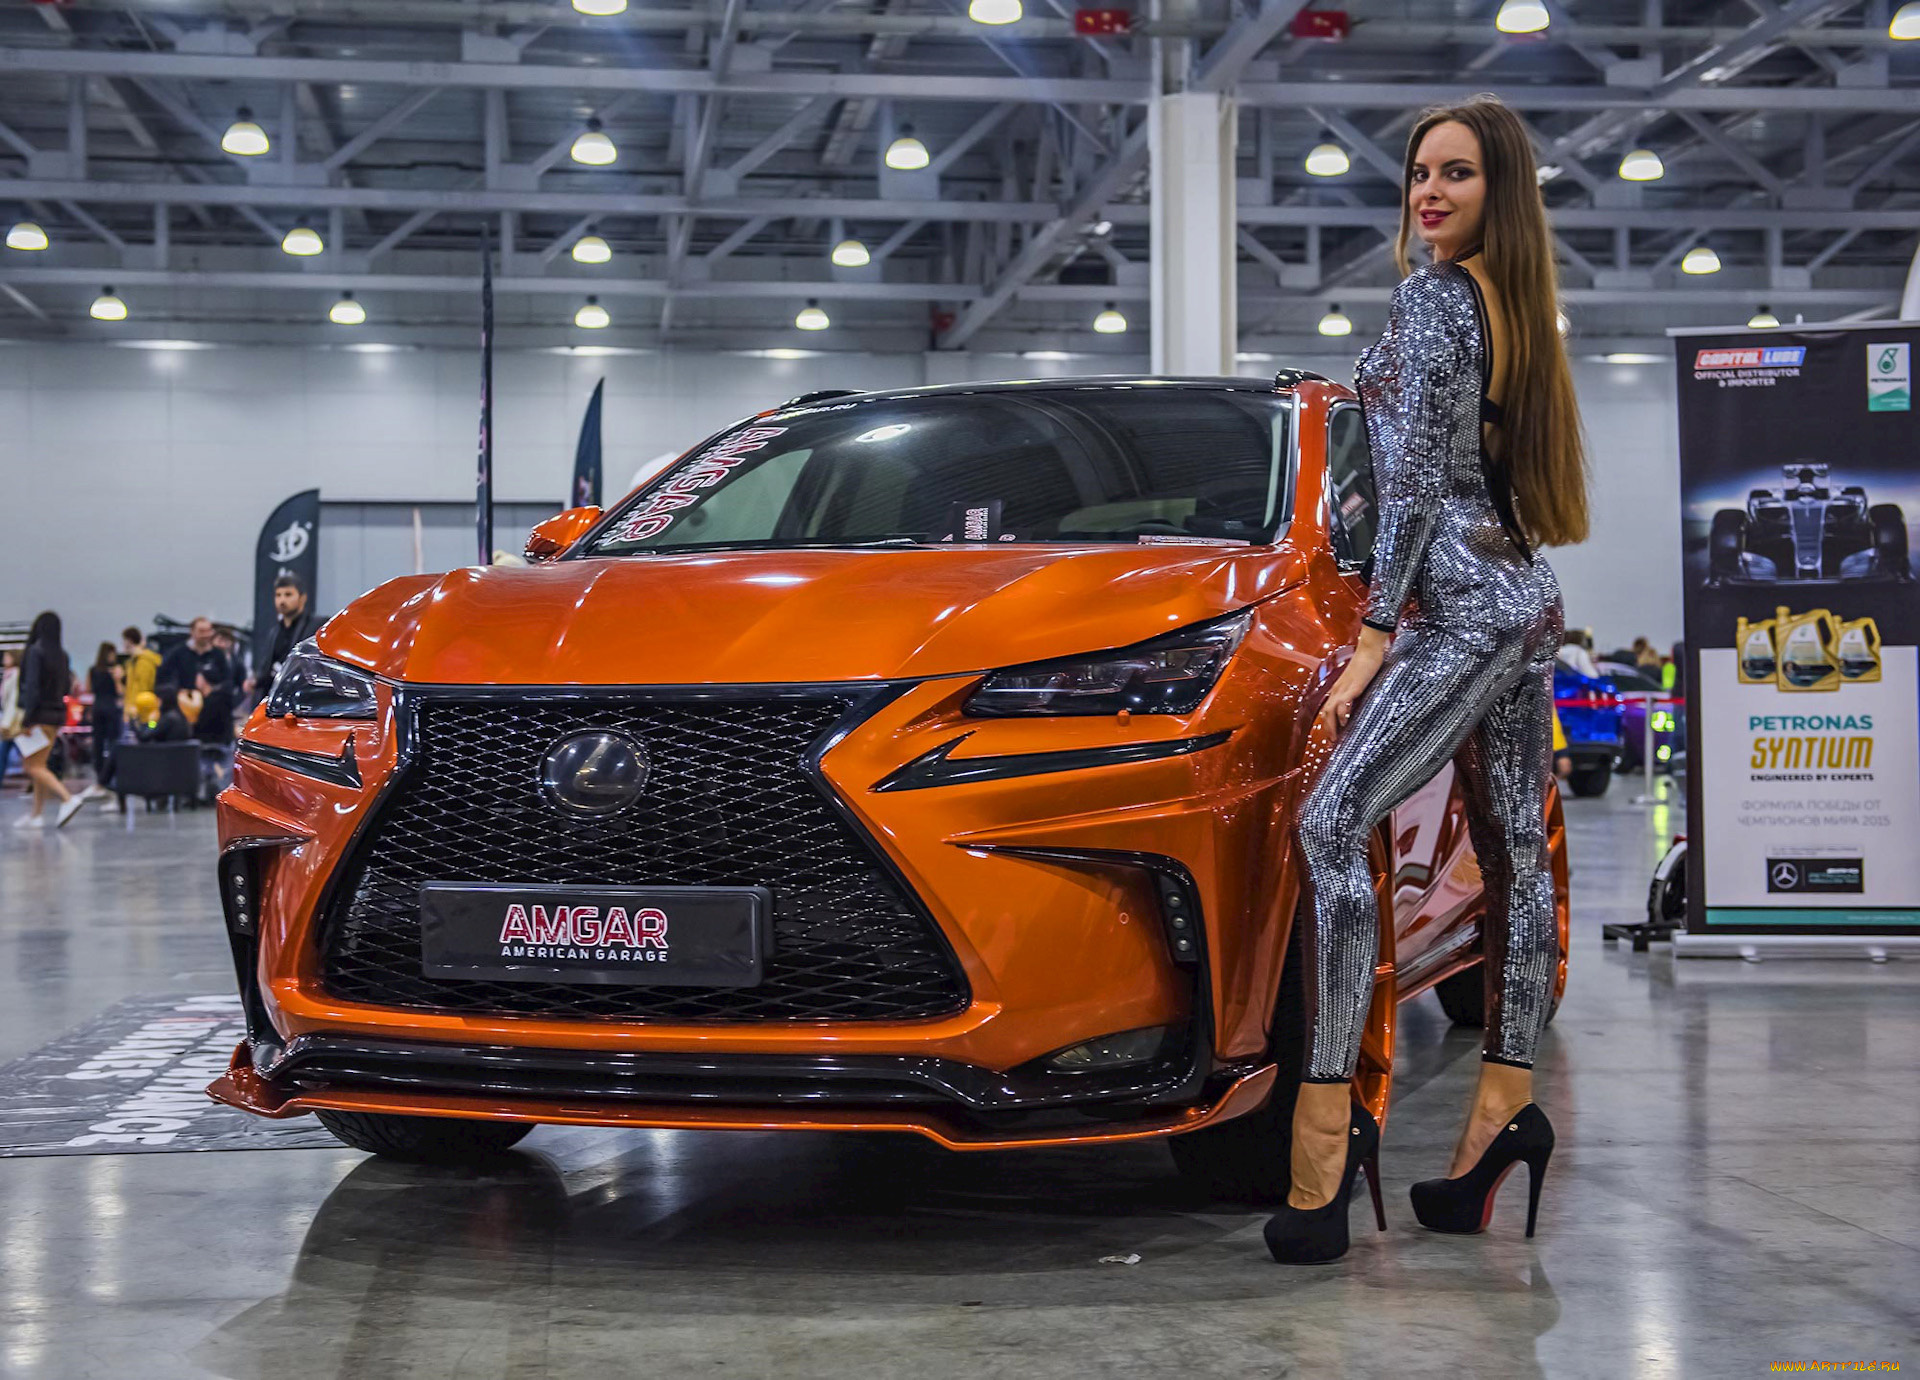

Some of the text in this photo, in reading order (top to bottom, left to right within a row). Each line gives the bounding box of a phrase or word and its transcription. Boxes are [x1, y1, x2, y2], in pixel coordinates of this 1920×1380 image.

[1694, 367, 1800, 380] OFFICIAL DISTRIBUTOR
[600, 427, 789, 546] AMGAR
[1749, 715, 1873, 731] PETRONAS
[1750, 737, 1874, 769] SYNTIUM
[1750, 774, 1813, 782] ENGINEERED
[1831, 773, 1874, 781] EXPERTS
[1741, 800, 1804, 811] ФОРМУЛА
[1863, 799, 1881, 811] ОТ
[1823, 815, 1859, 827] МИРА
[1862, 814, 1890, 827] 2015
[500, 904, 669, 948] AMGAR
[501, 946, 668, 962] AMERICAN GARAGE
[64, 1021, 221, 1081] BRAKES
